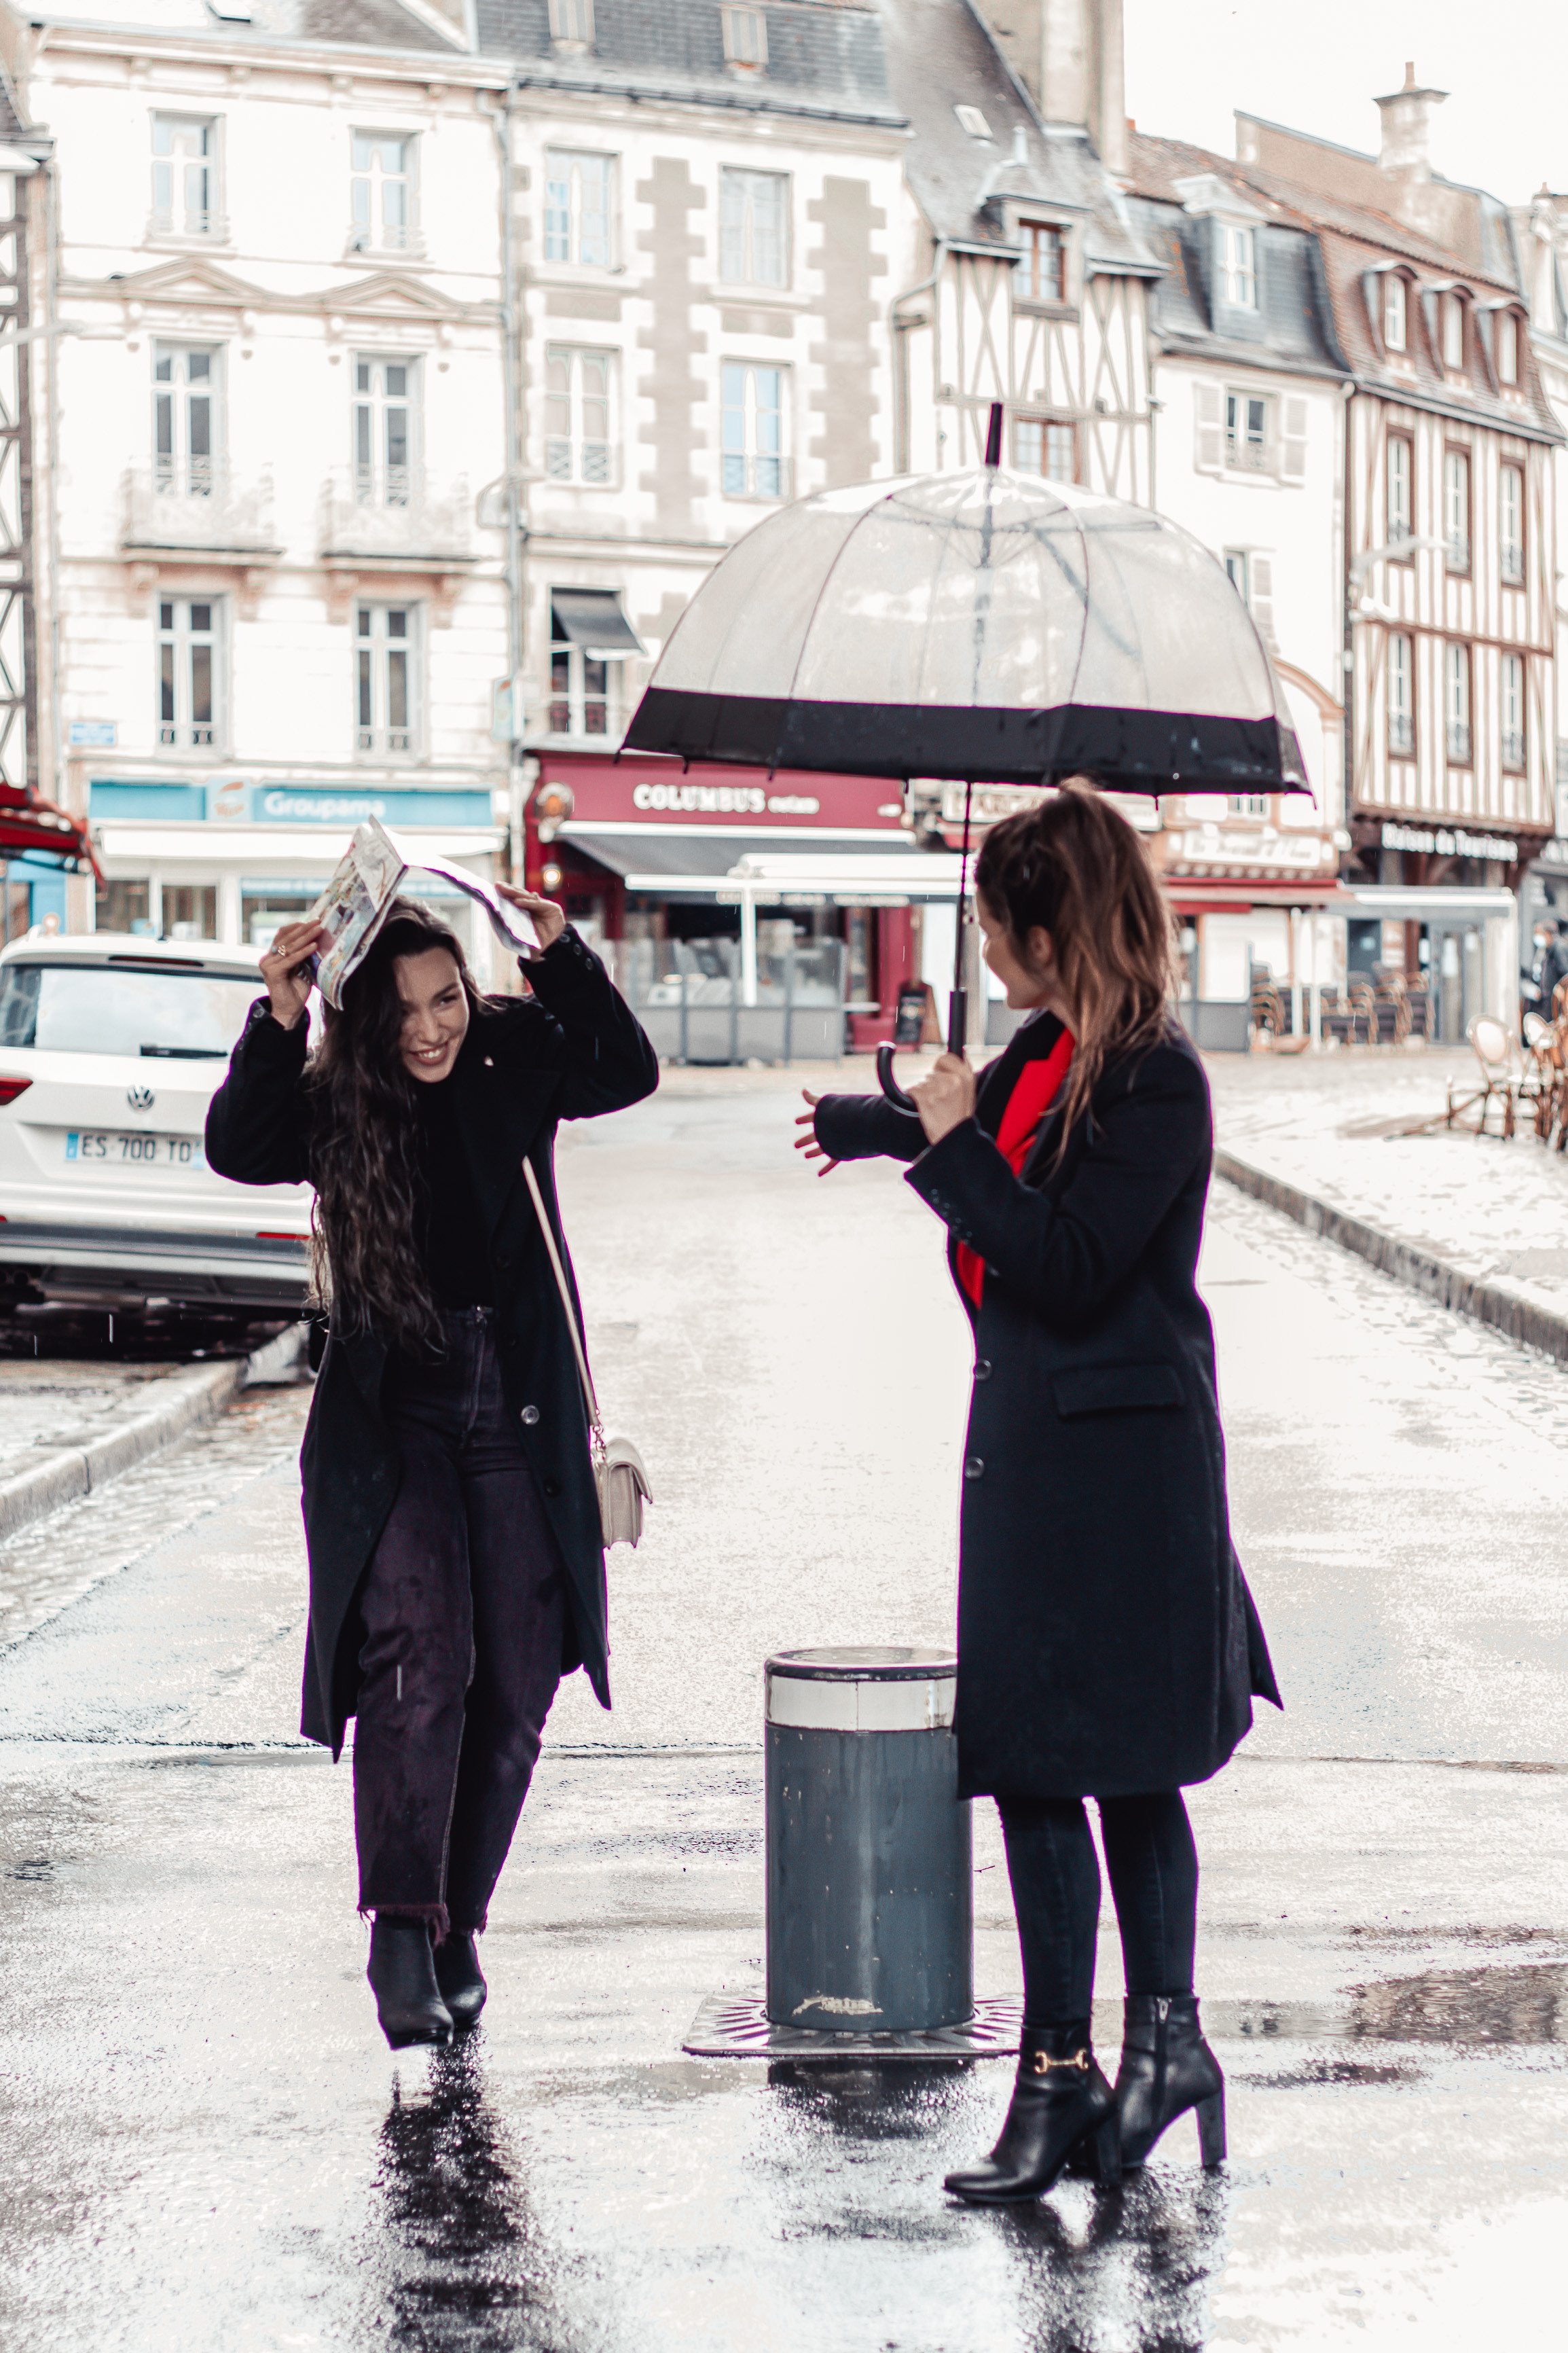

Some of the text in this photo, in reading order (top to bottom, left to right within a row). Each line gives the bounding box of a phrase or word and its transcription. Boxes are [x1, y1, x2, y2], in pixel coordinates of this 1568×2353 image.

[265, 791, 386, 820] Groupama
[634, 784, 765, 813] COLUMBUS
[82, 1136, 107, 1156] ES
[118, 1137, 156, 1160] 700
